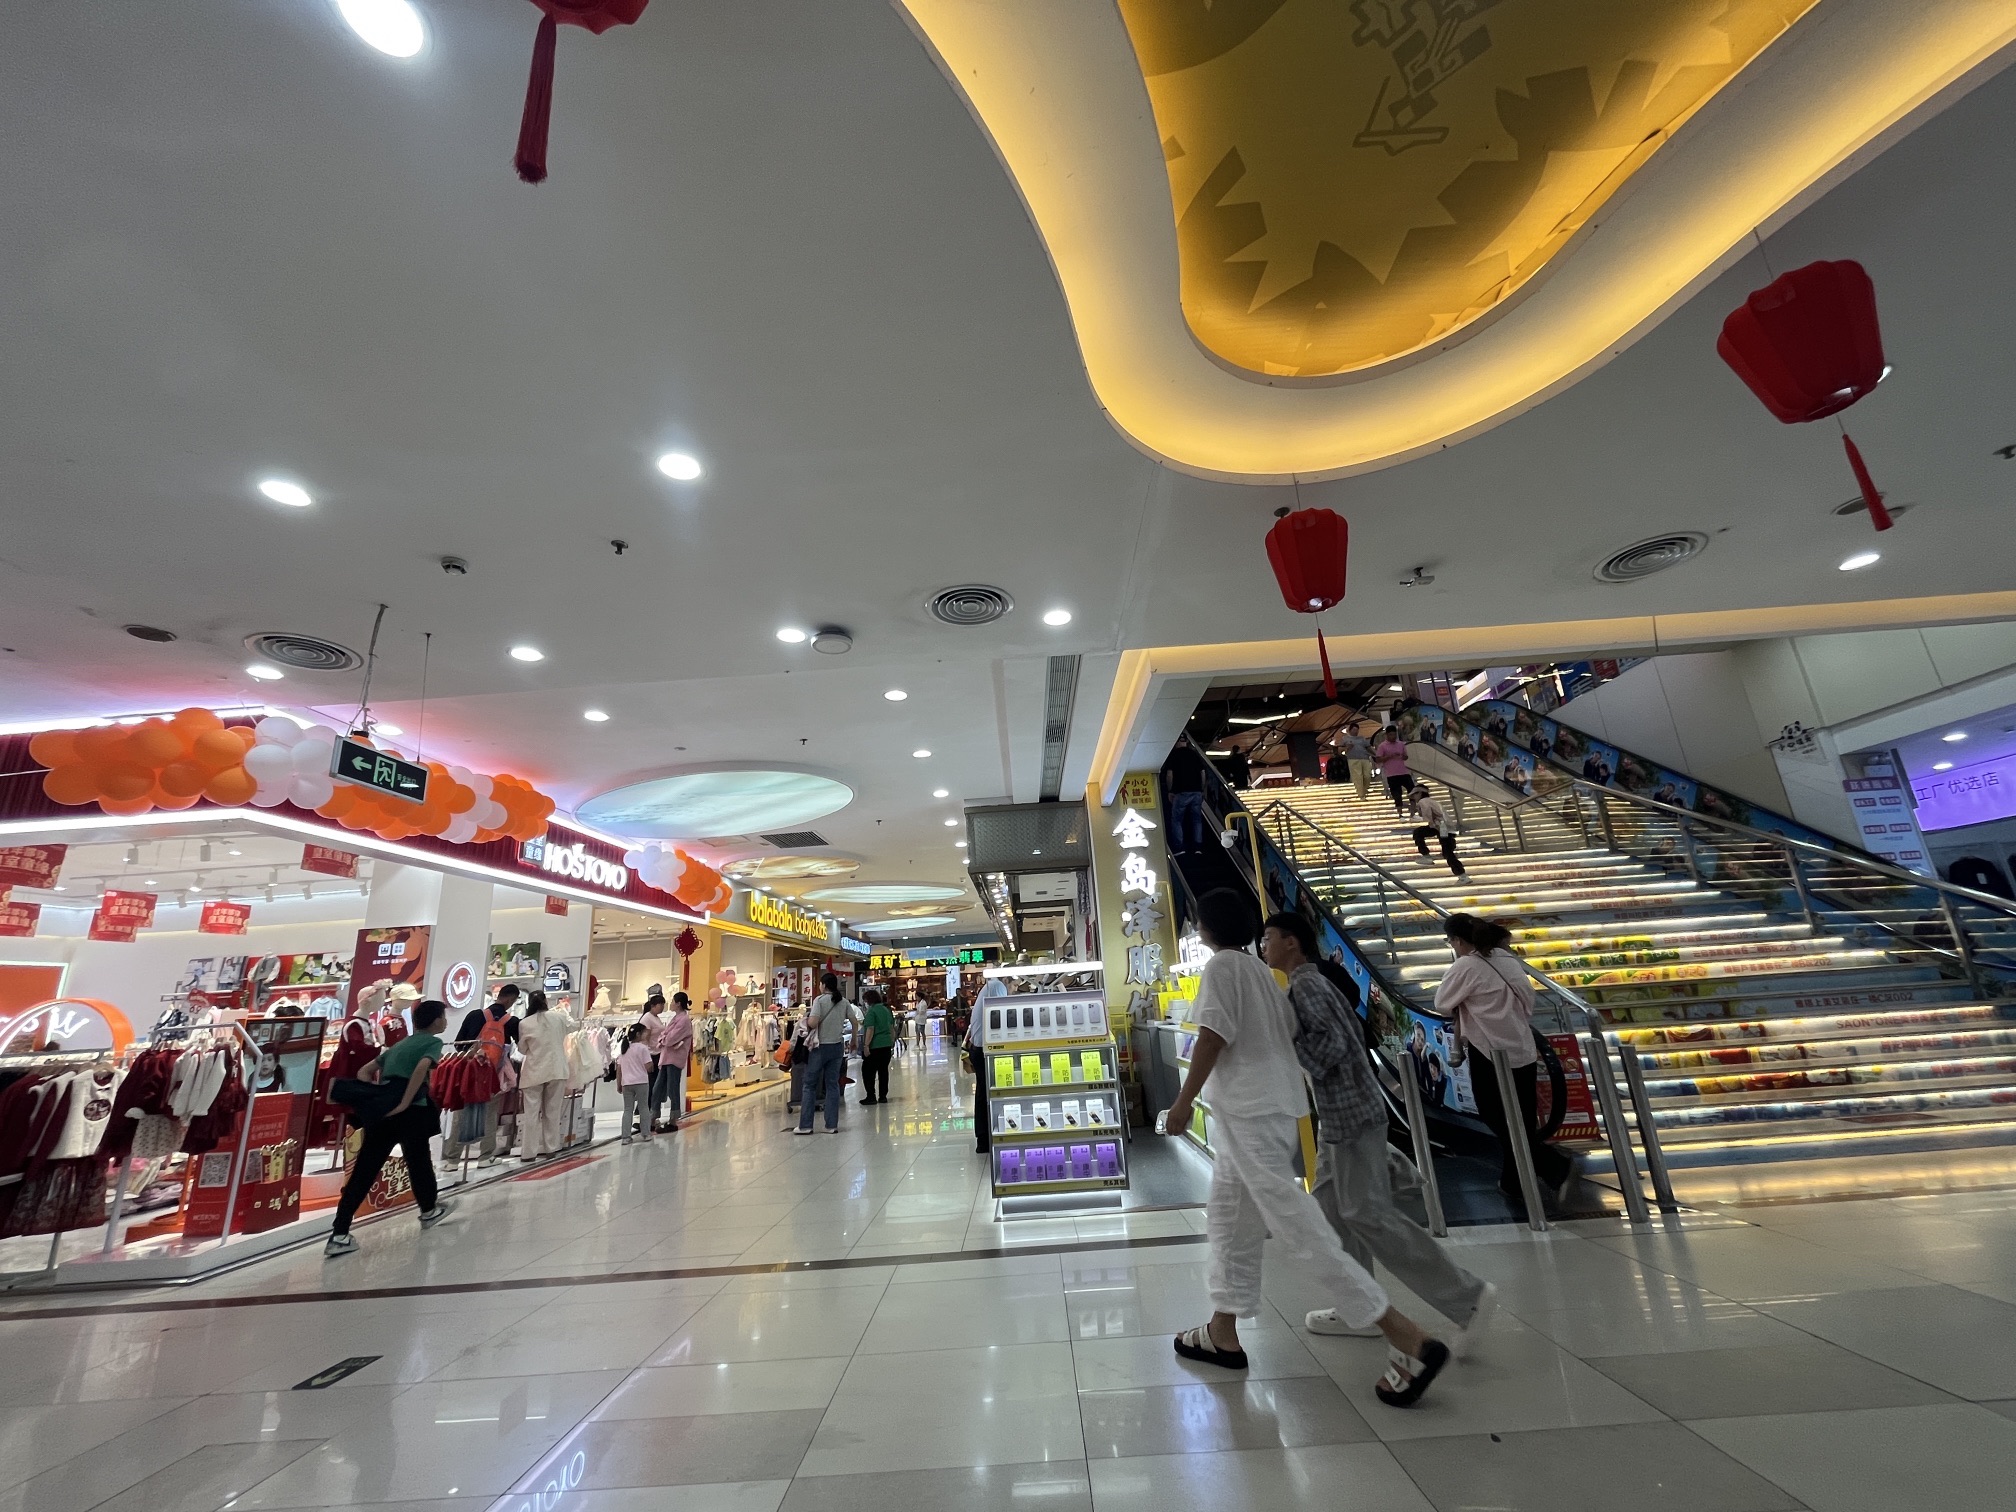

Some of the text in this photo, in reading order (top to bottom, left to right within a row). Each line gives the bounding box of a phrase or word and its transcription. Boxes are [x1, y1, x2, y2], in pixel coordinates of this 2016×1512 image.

[1131, 779, 1149, 787] 小心
[1916, 772, 2000, 801] 工厂优选店
[543, 843, 628, 890] HOSTOYO
[749, 889, 828, 941] balabala baby&kids
